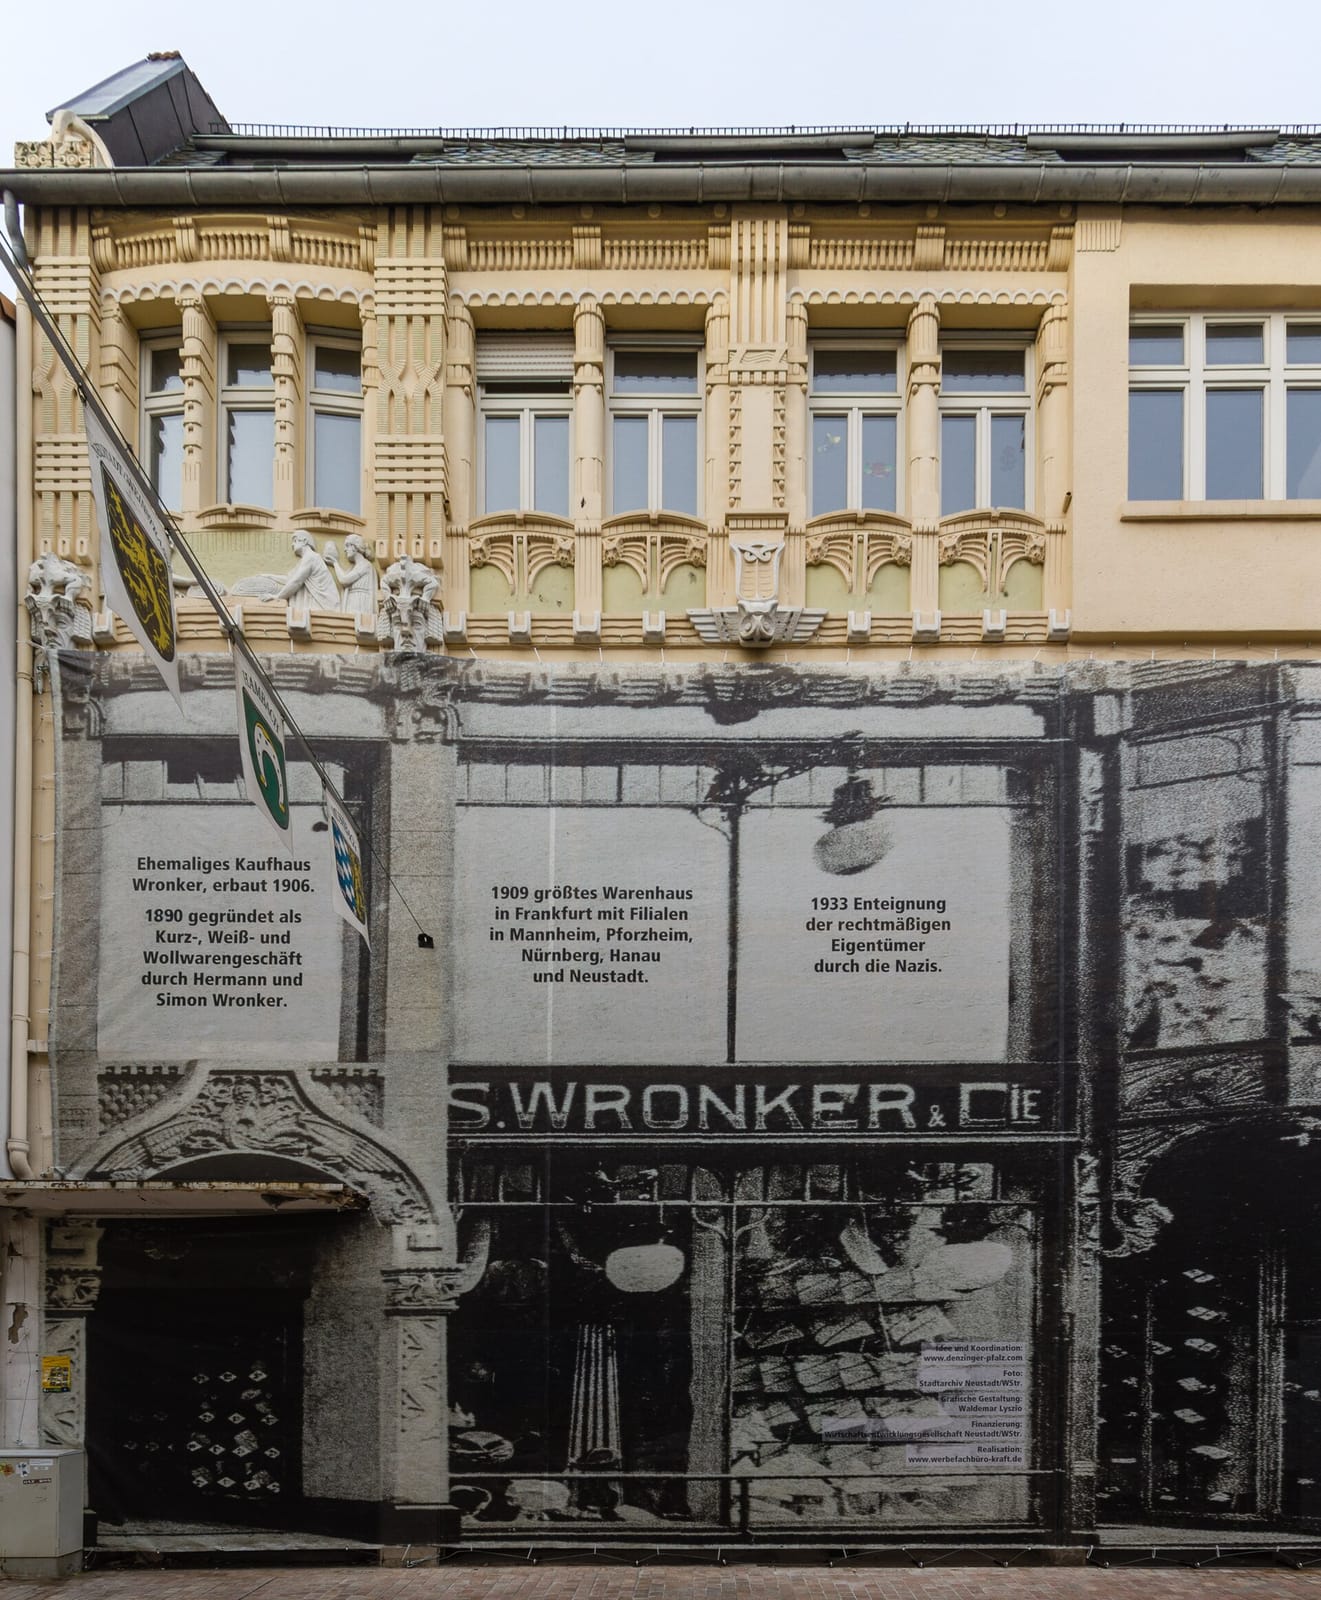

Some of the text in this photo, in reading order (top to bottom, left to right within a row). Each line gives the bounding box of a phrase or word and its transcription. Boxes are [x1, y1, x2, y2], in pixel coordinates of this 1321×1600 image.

[138, 856, 310, 874] Ehemaliges Kaufhaus
[132, 877, 314, 893] Wronker, erbaut 1906.
[492, 885, 693, 903] 1909 größtes Warenhaus
[812, 897, 946, 913] 1933 Enteignung
[146, 909, 301, 926] 1890 gegründet als
[495, 906, 688, 920] in Frankfurt mit Filialen
[806, 917, 950, 934] der rechtmäßigen
[156, 930, 290, 945] Kurz-, Weiß- und
[490, 927, 692, 943] in Mannheim, Pforzheim,
[832, 938, 925, 955] Eigentümer
[143, 950, 302, 968] Wollwarengeschäft
[522, 948, 660, 965] Nürnberg, Hanau
[814, 959, 941, 972] durch die Nazis.
[142, 971, 302, 986] durch Hermann und
[534, 969, 648, 982] und Neustadt.
[157, 992, 287, 1007] Simon Wronker.
[928, 1104, 946, 1127] &
[954, 1344, 969, 1352] und
[970, 1344, 1023, 1352] Koordination:
[923, 1353, 1023, 1363] www.denzinger-pfalz.com
[1003, 1369, 1023, 1377] Foto:
[919, 1379, 1023, 1388] Stadtarchiv Neustadt/WStr.
[941, 1395, 1023, 1405] Grafische Gestaltung:
[958, 1404, 1023, 1415] Waldemar Lyszio
[971, 1420, 1023, 1430] Finanzierung:
[964, 1430, 1023, 1438] Neustadt/WStr.
[977, 1445, 1023, 1454] Realisation:
[908, 1455, 1023, 1463] www.werbefachbüro-kraft.de
